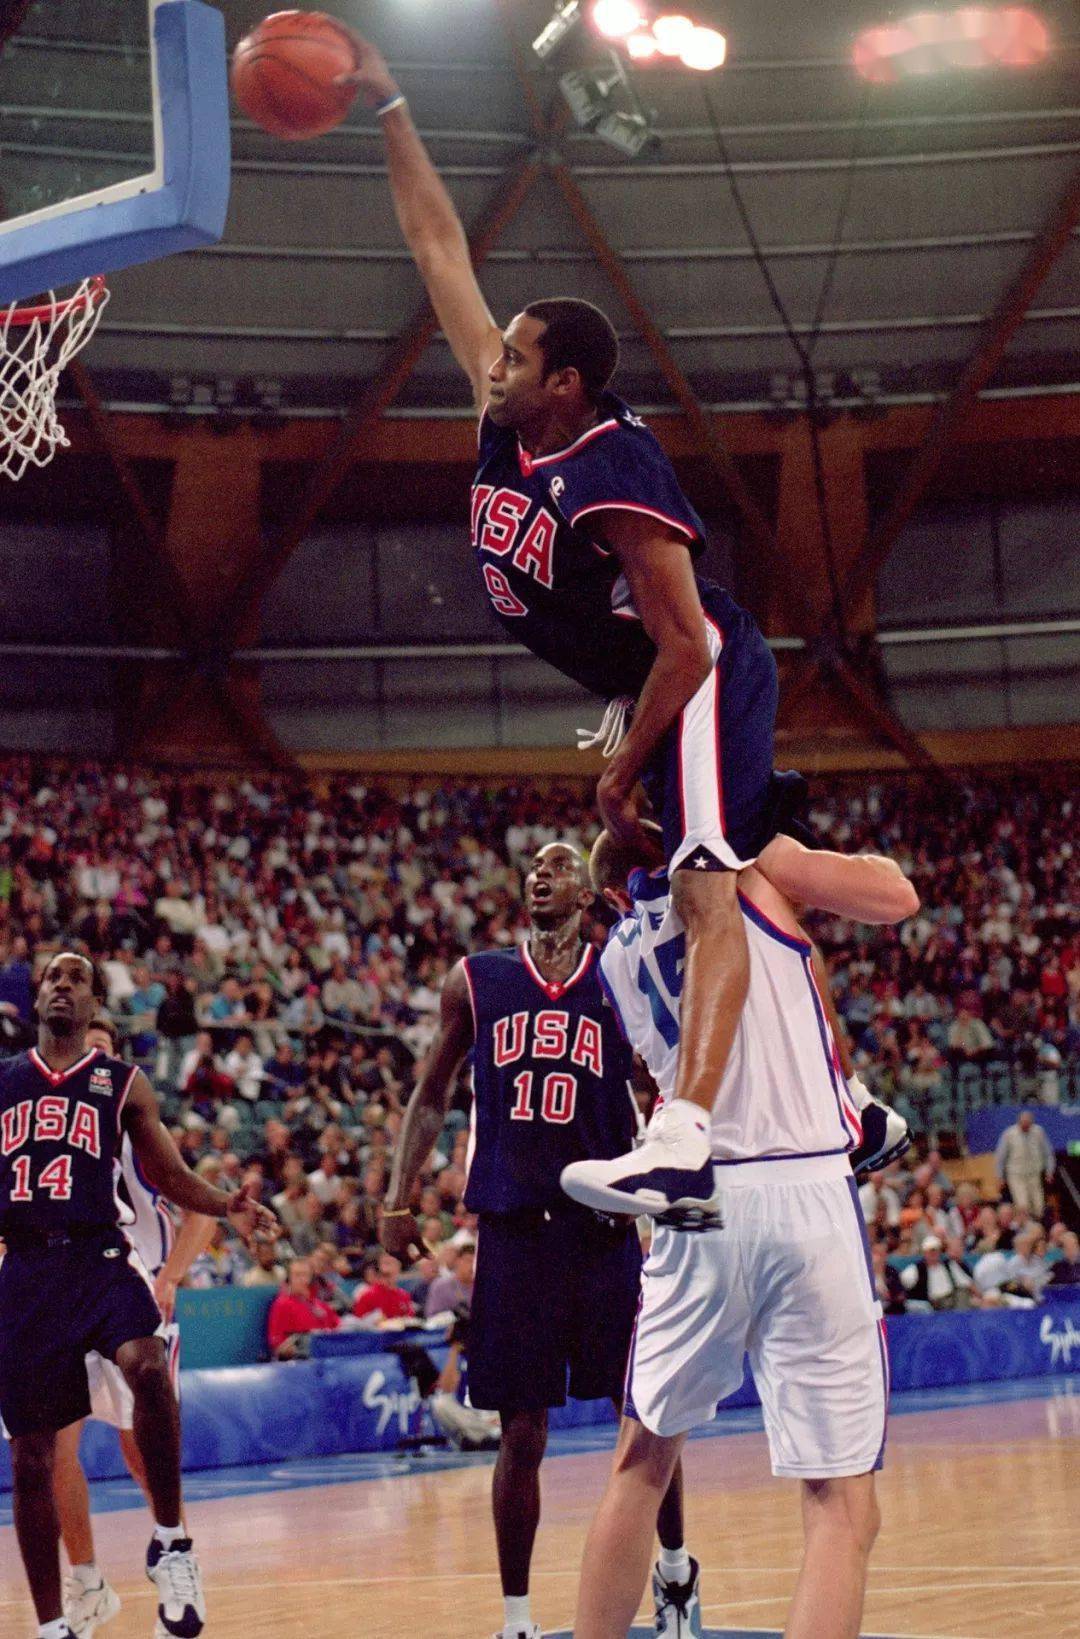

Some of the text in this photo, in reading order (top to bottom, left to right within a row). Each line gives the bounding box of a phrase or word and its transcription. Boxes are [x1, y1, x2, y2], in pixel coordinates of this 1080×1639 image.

[471, 484, 558, 589] USA
[482, 562, 529, 617] 9
[493, 1010, 604, 1079] USA
[0, 1095, 101, 1159] USA
[510, 1070, 578, 1125] 10
[10, 1154, 73, 1202] 14
